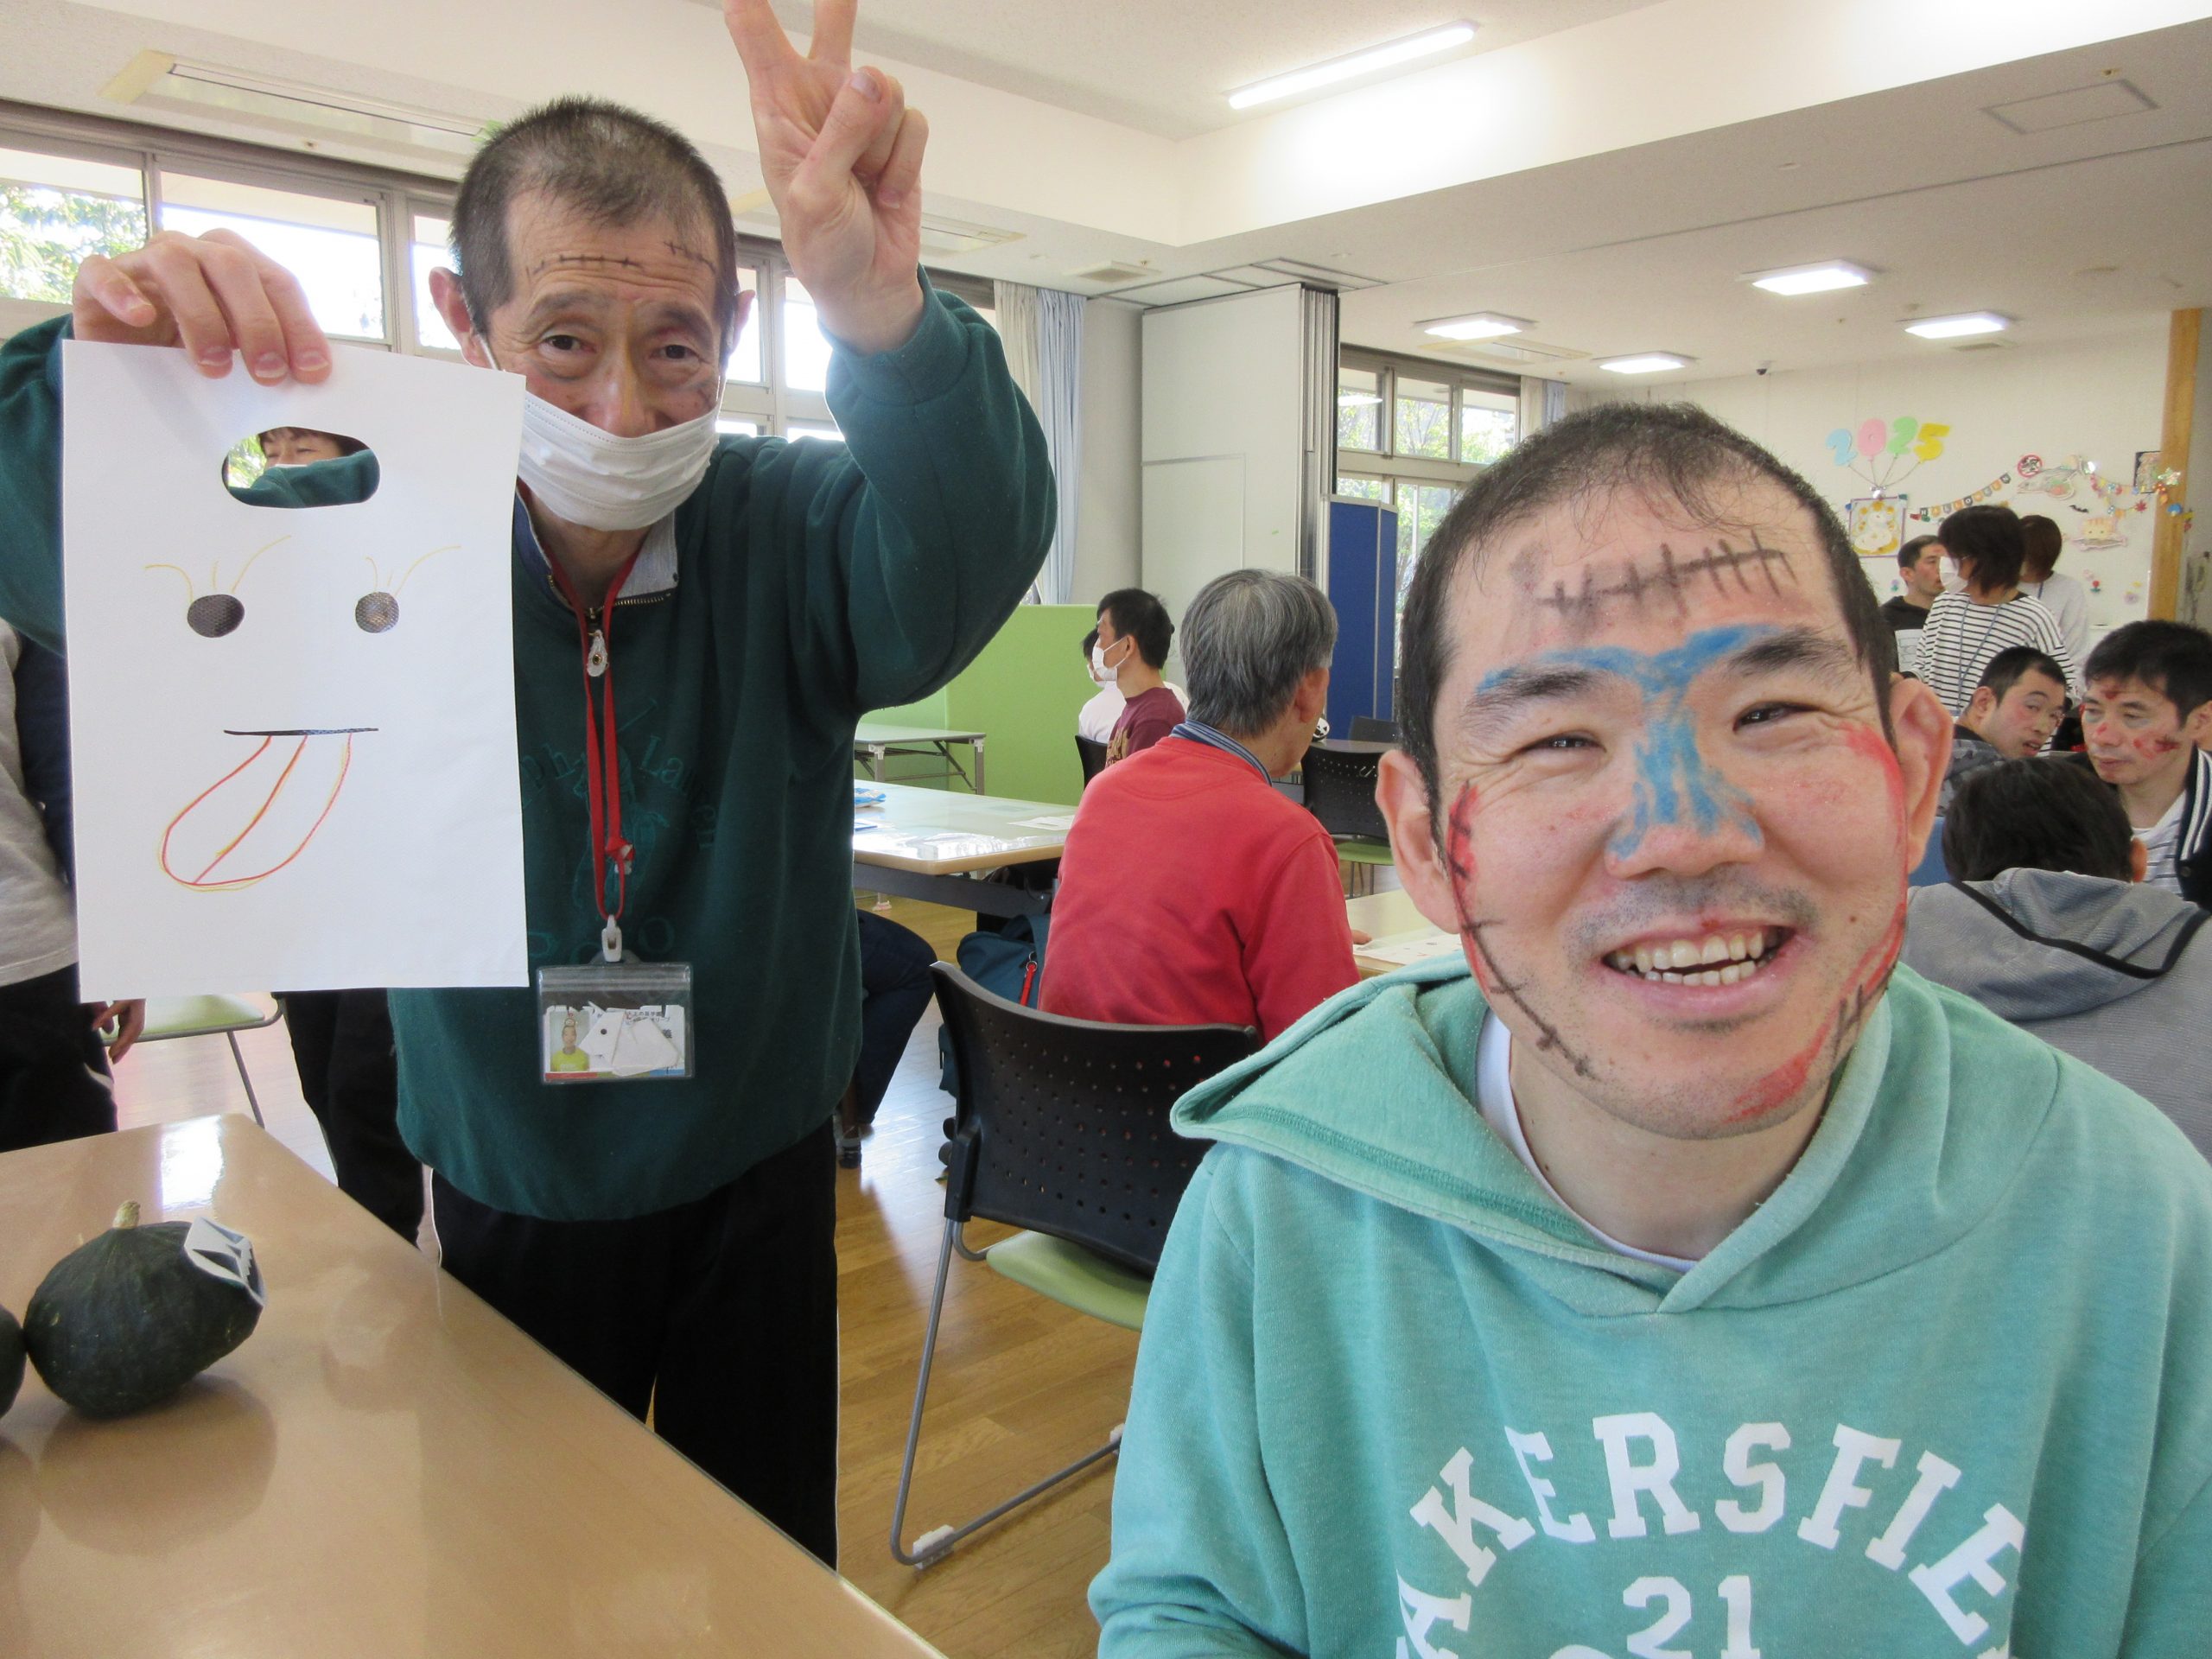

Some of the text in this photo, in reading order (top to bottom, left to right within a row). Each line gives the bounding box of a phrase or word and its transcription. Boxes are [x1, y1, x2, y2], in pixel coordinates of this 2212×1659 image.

[1825, 416, 1952, 467] 2025
[1395, 1411, 2026, 1659] AKERSFIE
[1622, 1575, 1762, 1659] 21
